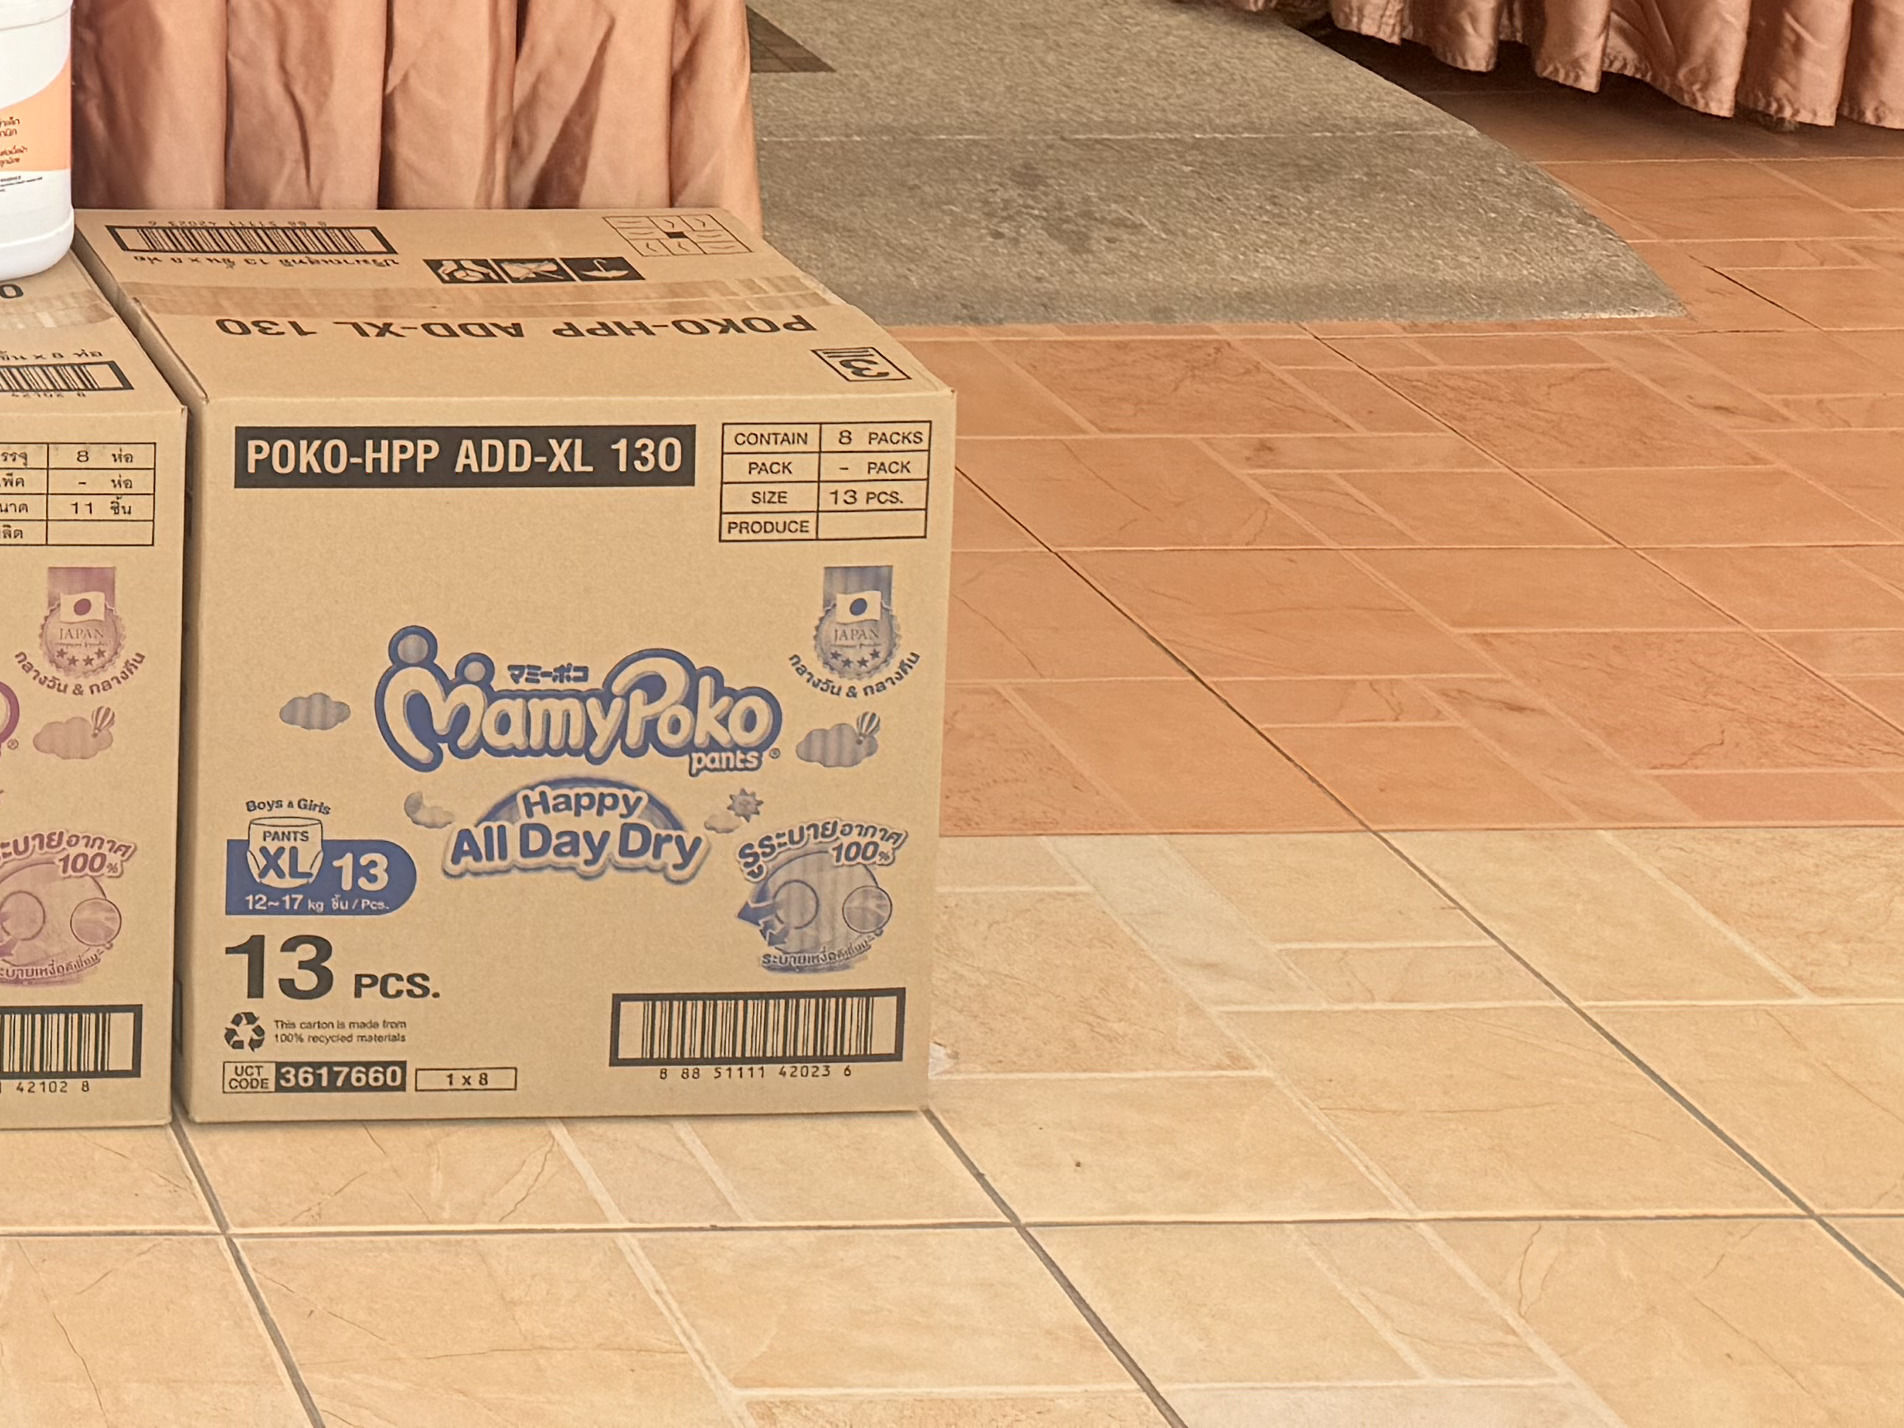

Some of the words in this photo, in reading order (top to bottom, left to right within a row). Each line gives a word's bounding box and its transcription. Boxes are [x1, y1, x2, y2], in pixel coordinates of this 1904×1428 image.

[245, 439, 440, 474] POKO-HPP
[454, 437, 595, 473] ADD-XL
[610, 436, 683, 472] 130
[375, 625, 782, 772] MamyPoko
[522, 787, 646, 819] Happy
[255, 846, 314, 883] XL
[224, 934, 334, 1001] 13
[353, 970, 441, 1000] PCS.
[278, 1064, 403, 1090] 3617660
